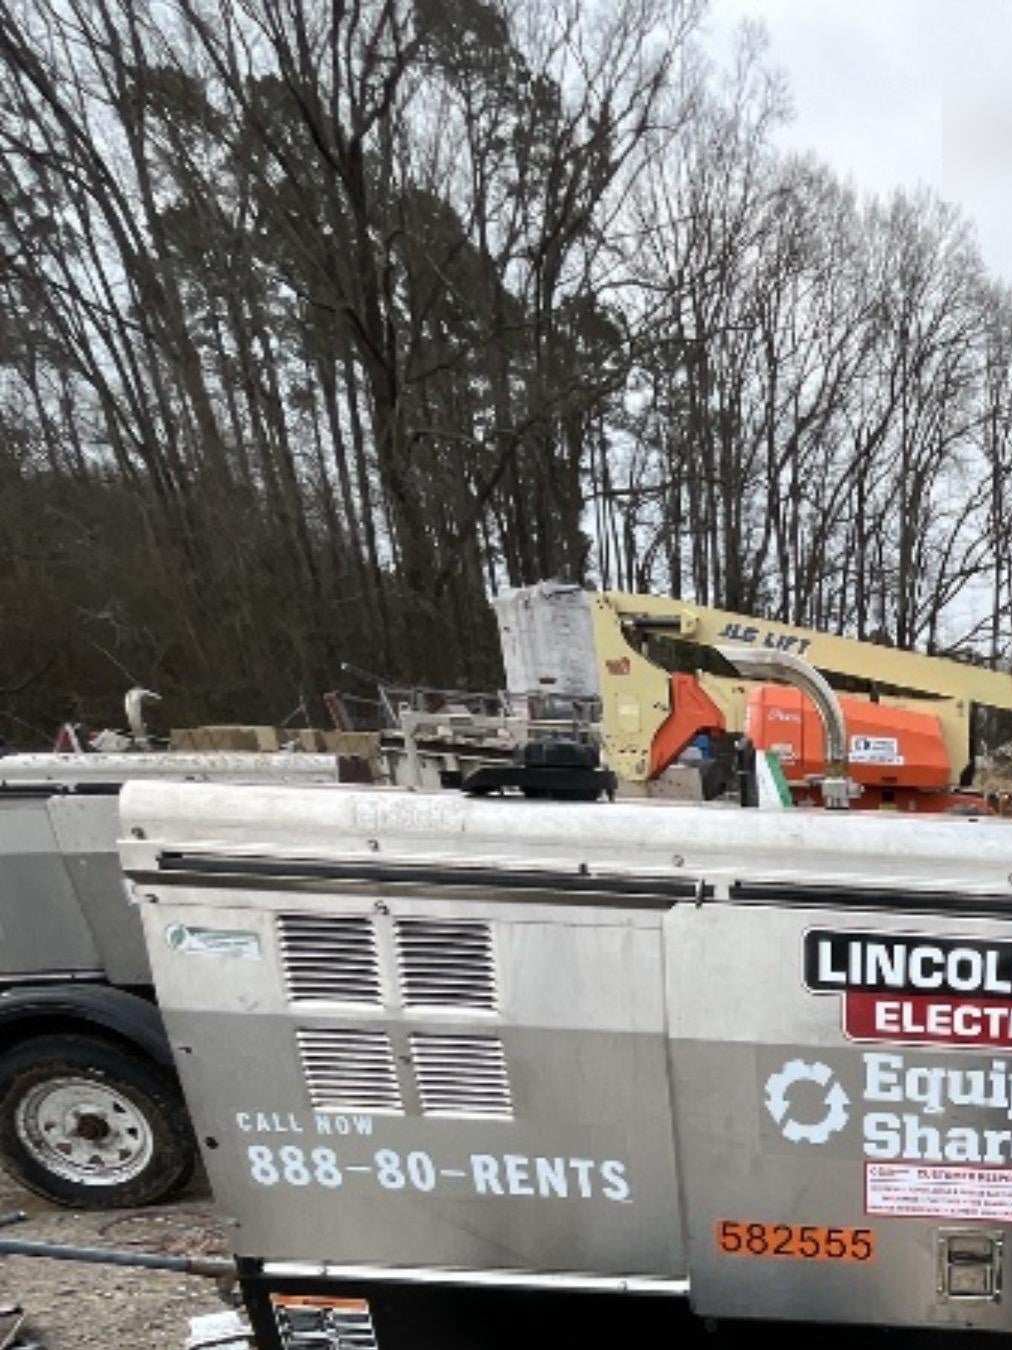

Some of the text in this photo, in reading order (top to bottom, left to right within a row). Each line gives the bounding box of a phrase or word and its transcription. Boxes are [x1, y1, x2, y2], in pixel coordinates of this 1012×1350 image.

[236, 1112, 374, 1136] CALL NOW
[248, 1144, 632, 1201] 888-80-RENTS
[718, 1221, 873, 1260] 582555
